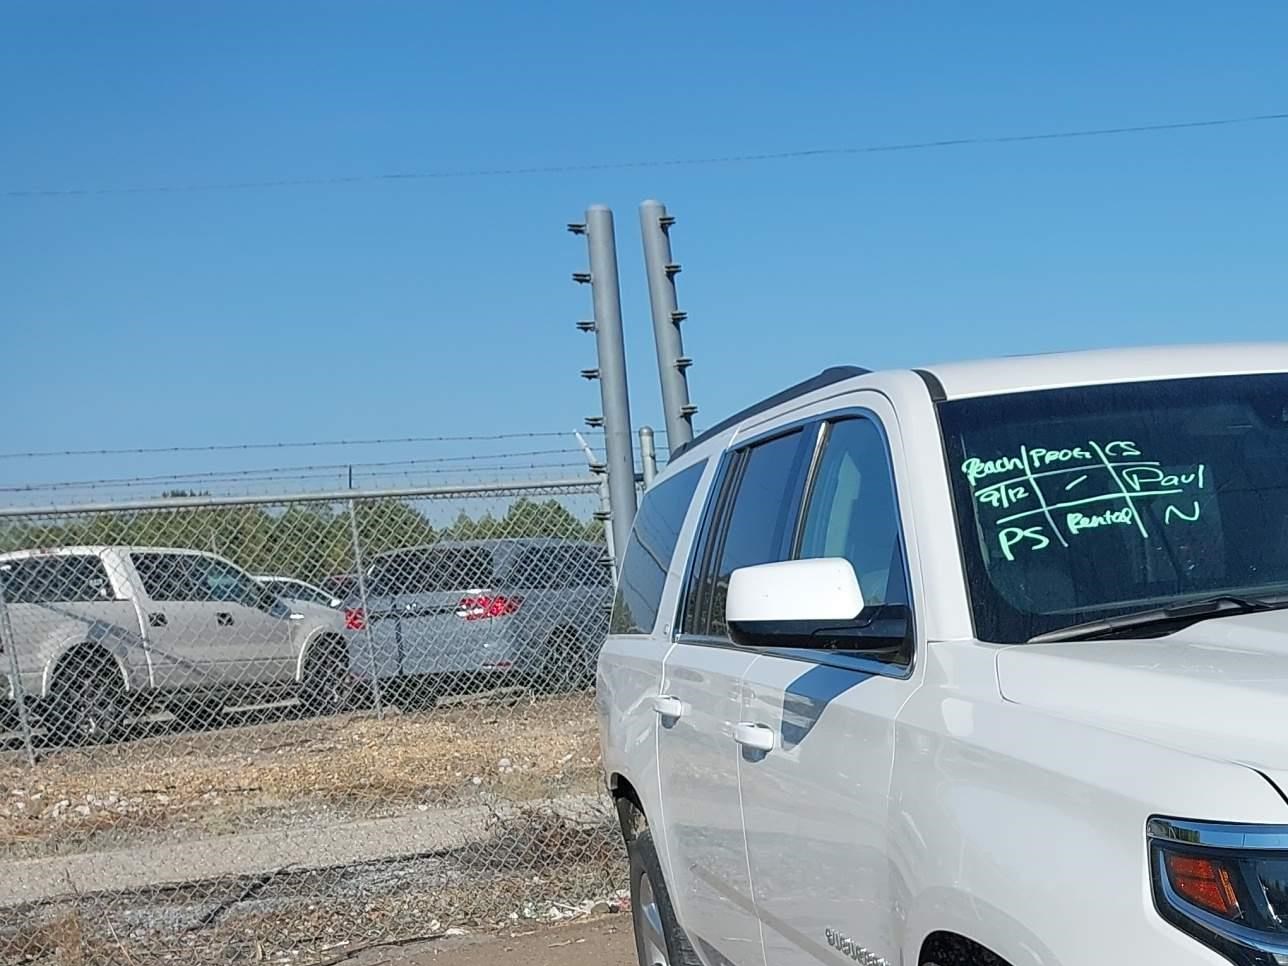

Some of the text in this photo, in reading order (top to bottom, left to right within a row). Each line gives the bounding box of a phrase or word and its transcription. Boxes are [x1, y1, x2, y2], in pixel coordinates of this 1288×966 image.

[1122, 464, 1204, 491] Paul
[999, 527, 1050, 561] PS
[1165, 501, 1200, 524] N
